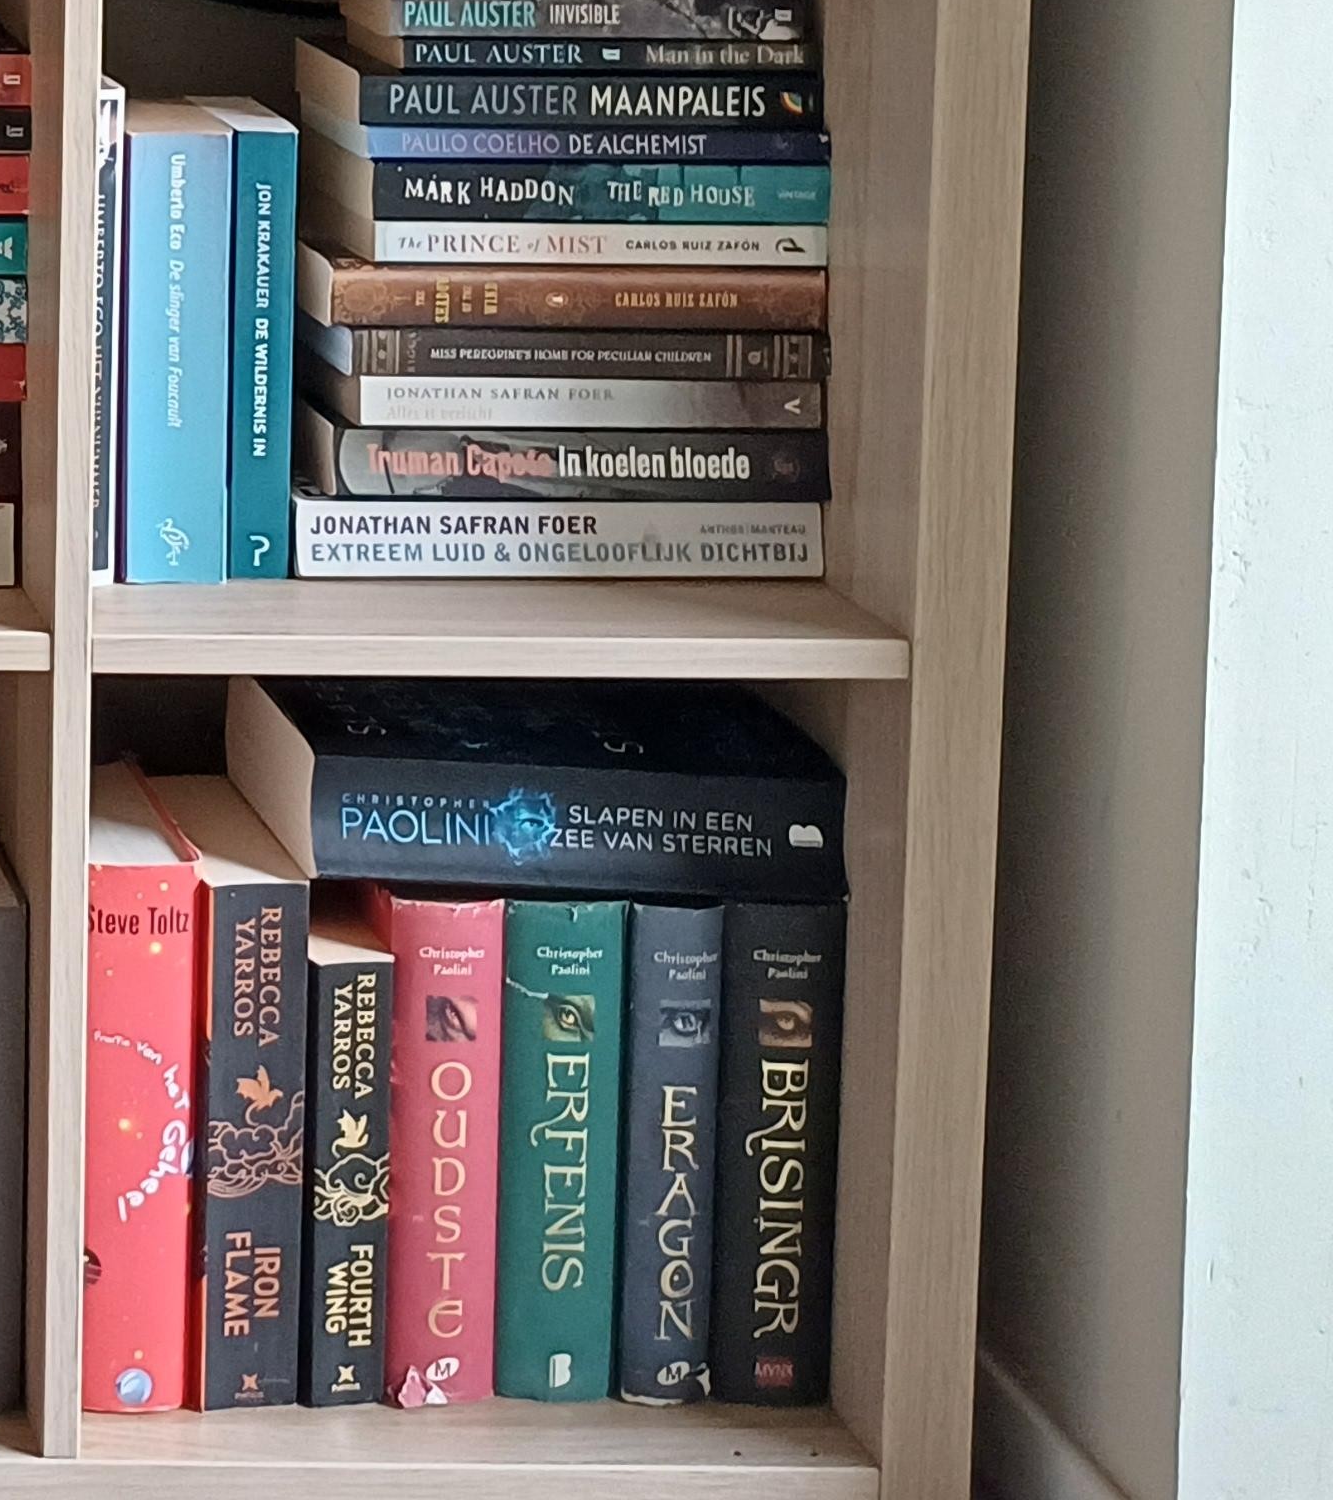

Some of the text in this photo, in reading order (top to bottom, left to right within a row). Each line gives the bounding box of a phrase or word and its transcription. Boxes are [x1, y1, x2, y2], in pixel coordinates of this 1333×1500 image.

[403, 1, 536, 27] PAUL AUSTER
[590, 85, 766, 117] MAANPALEIS
[311, 516, 597, 535] JONATHAN SAFRAN FOER
[342, 808, 490, 845] PAOLINI
[549, 829, 772, 857] ZEE VAN STERREN
[569, 805, 752, 832] SLAPEN IN EEN
[233, 918, 256, 1037] YARROS
[257, 907, 283, 1049] REBECCA
[426, 1061, 473, 1339] OUDSTE
[529, 1053, 590, 1291] ERFENIS
[653, 1085, 699, 1341] ERAGON
[745, 1061, 810, 1339] BRISINGR
[224, 1231, 250, 1337] FLAME
[252, 1247, 279, 1317] IRON
